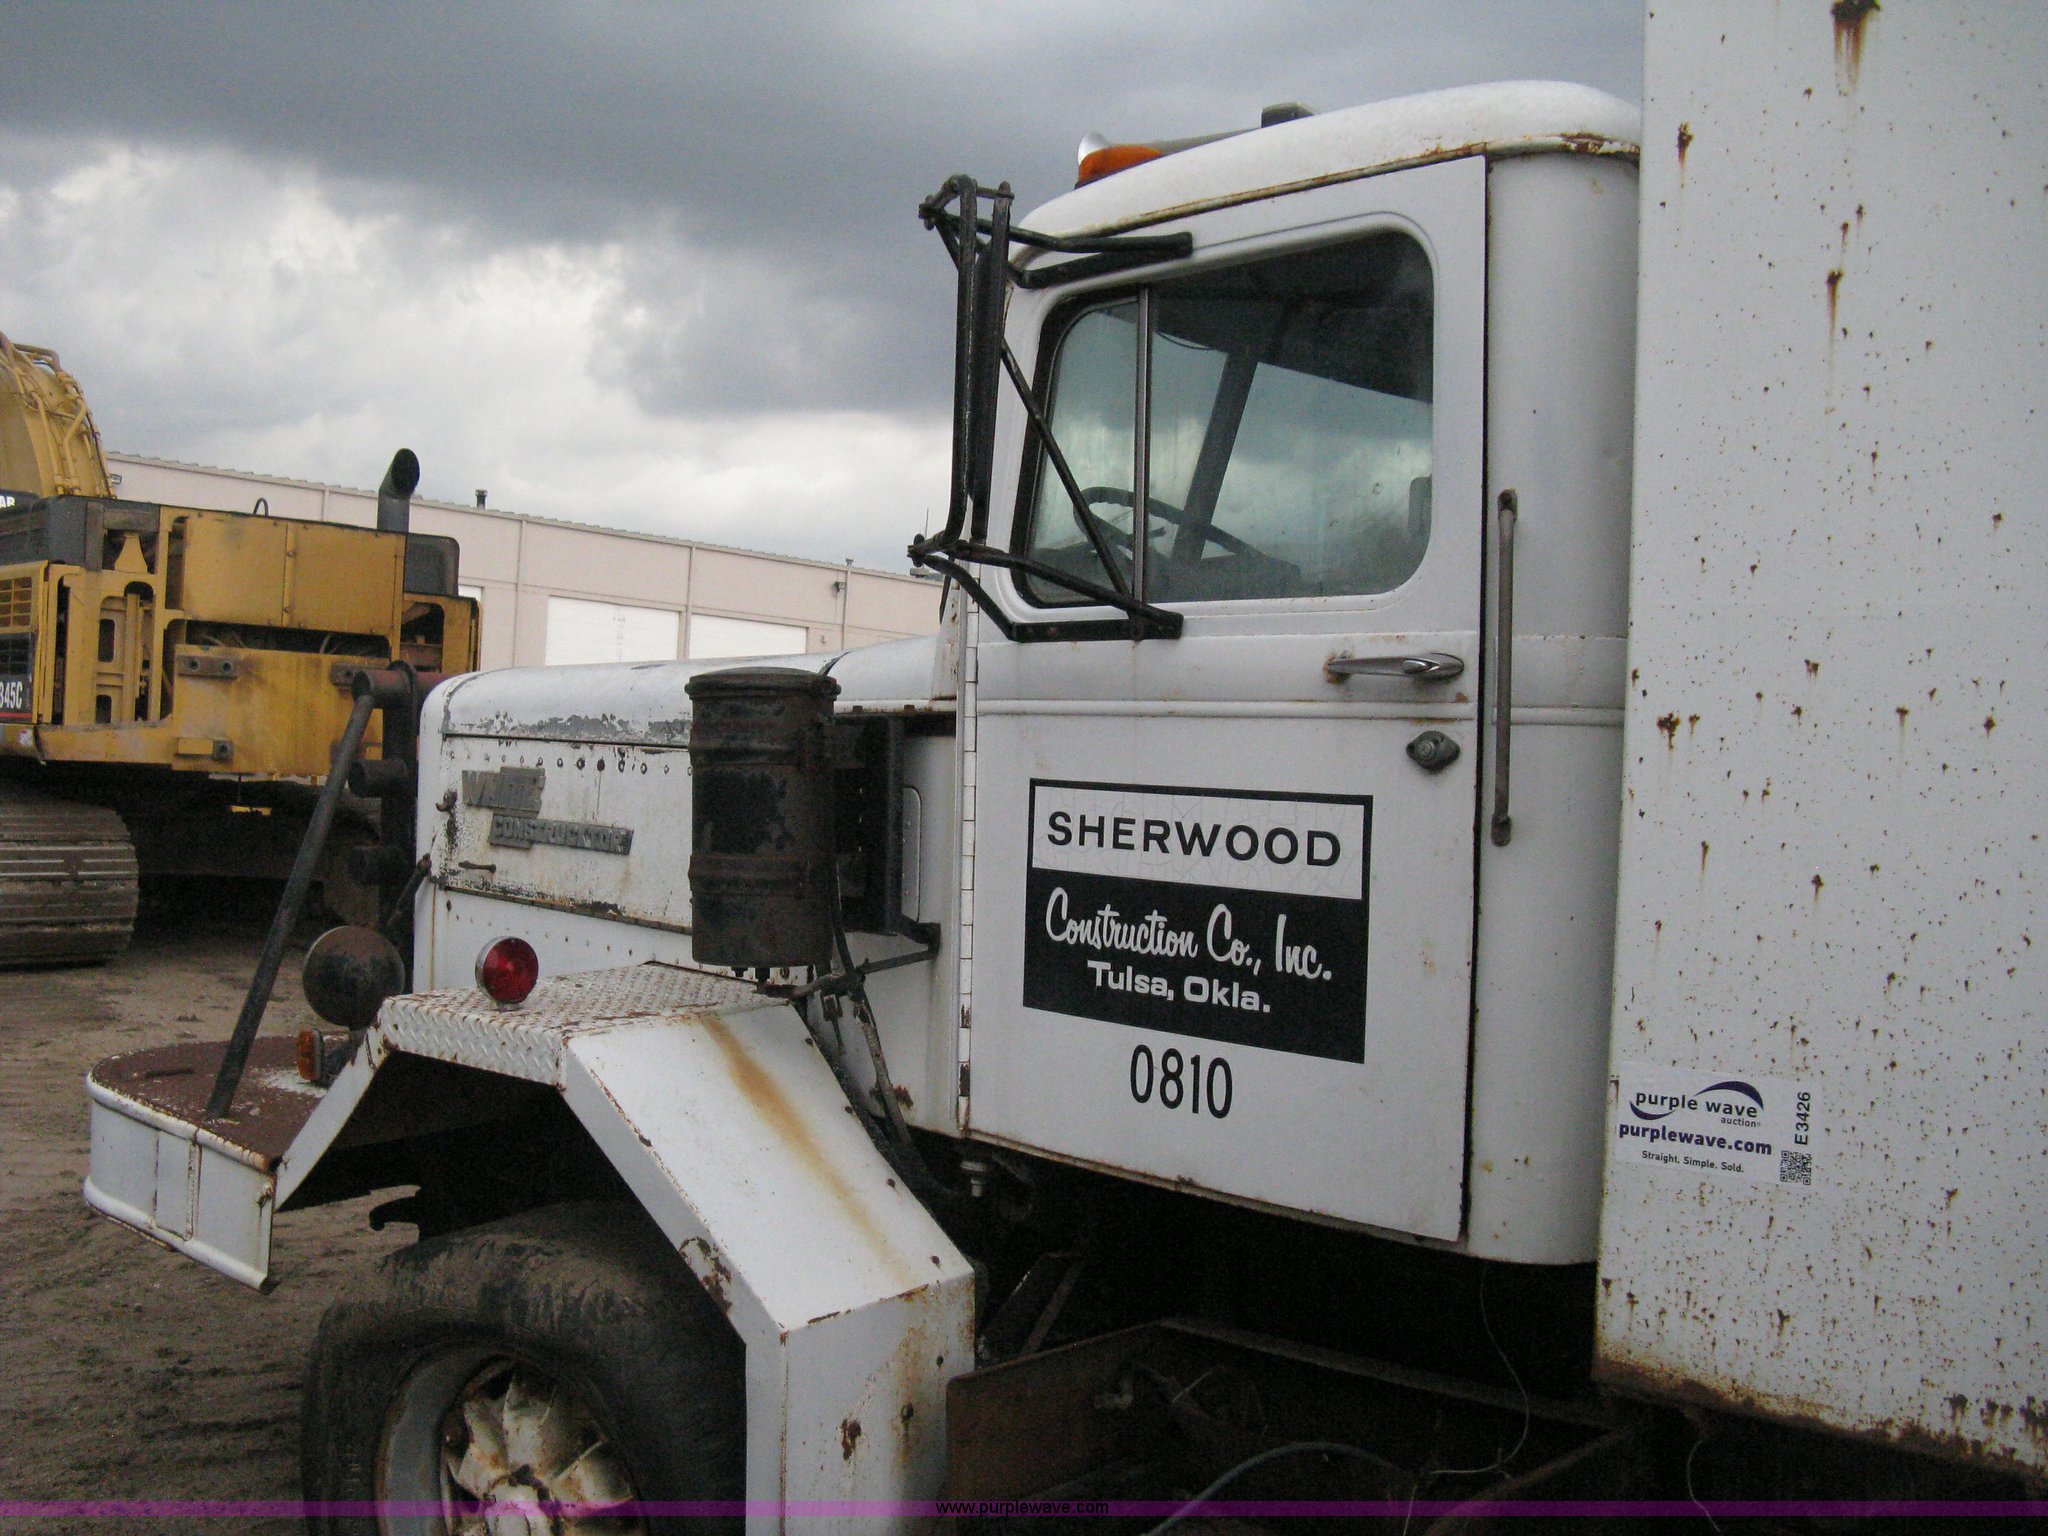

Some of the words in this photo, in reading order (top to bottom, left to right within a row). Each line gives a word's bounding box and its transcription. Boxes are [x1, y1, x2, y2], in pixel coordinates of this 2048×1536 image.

[1047, 811, 1341, 867] SHERWOOD
[1045, 886, 1198, 959] Construction
[1206, 903, 1261, 976] Co.,
[1275, 914, 1332, 981] Inc.
[1087, 959, 1174, 1001] Tulsa,
[1184, 975, 1271, 1013] Okla.
[1130, 1044, 1233, 1119] 0810
[1635, 1091, 1698, 1111] purple
[1706, 1100, 1758, 1118] wave
[1618, 1122, 1773, 1156] purplewave.com
[1794, 1091, 1811, 1146] E3426
[1641, 1150, 1681, 1164] Straight.
[1683, 1156, 1718, 1170] Simple.
[1720, 1161, 1745, 1174] Sold.
